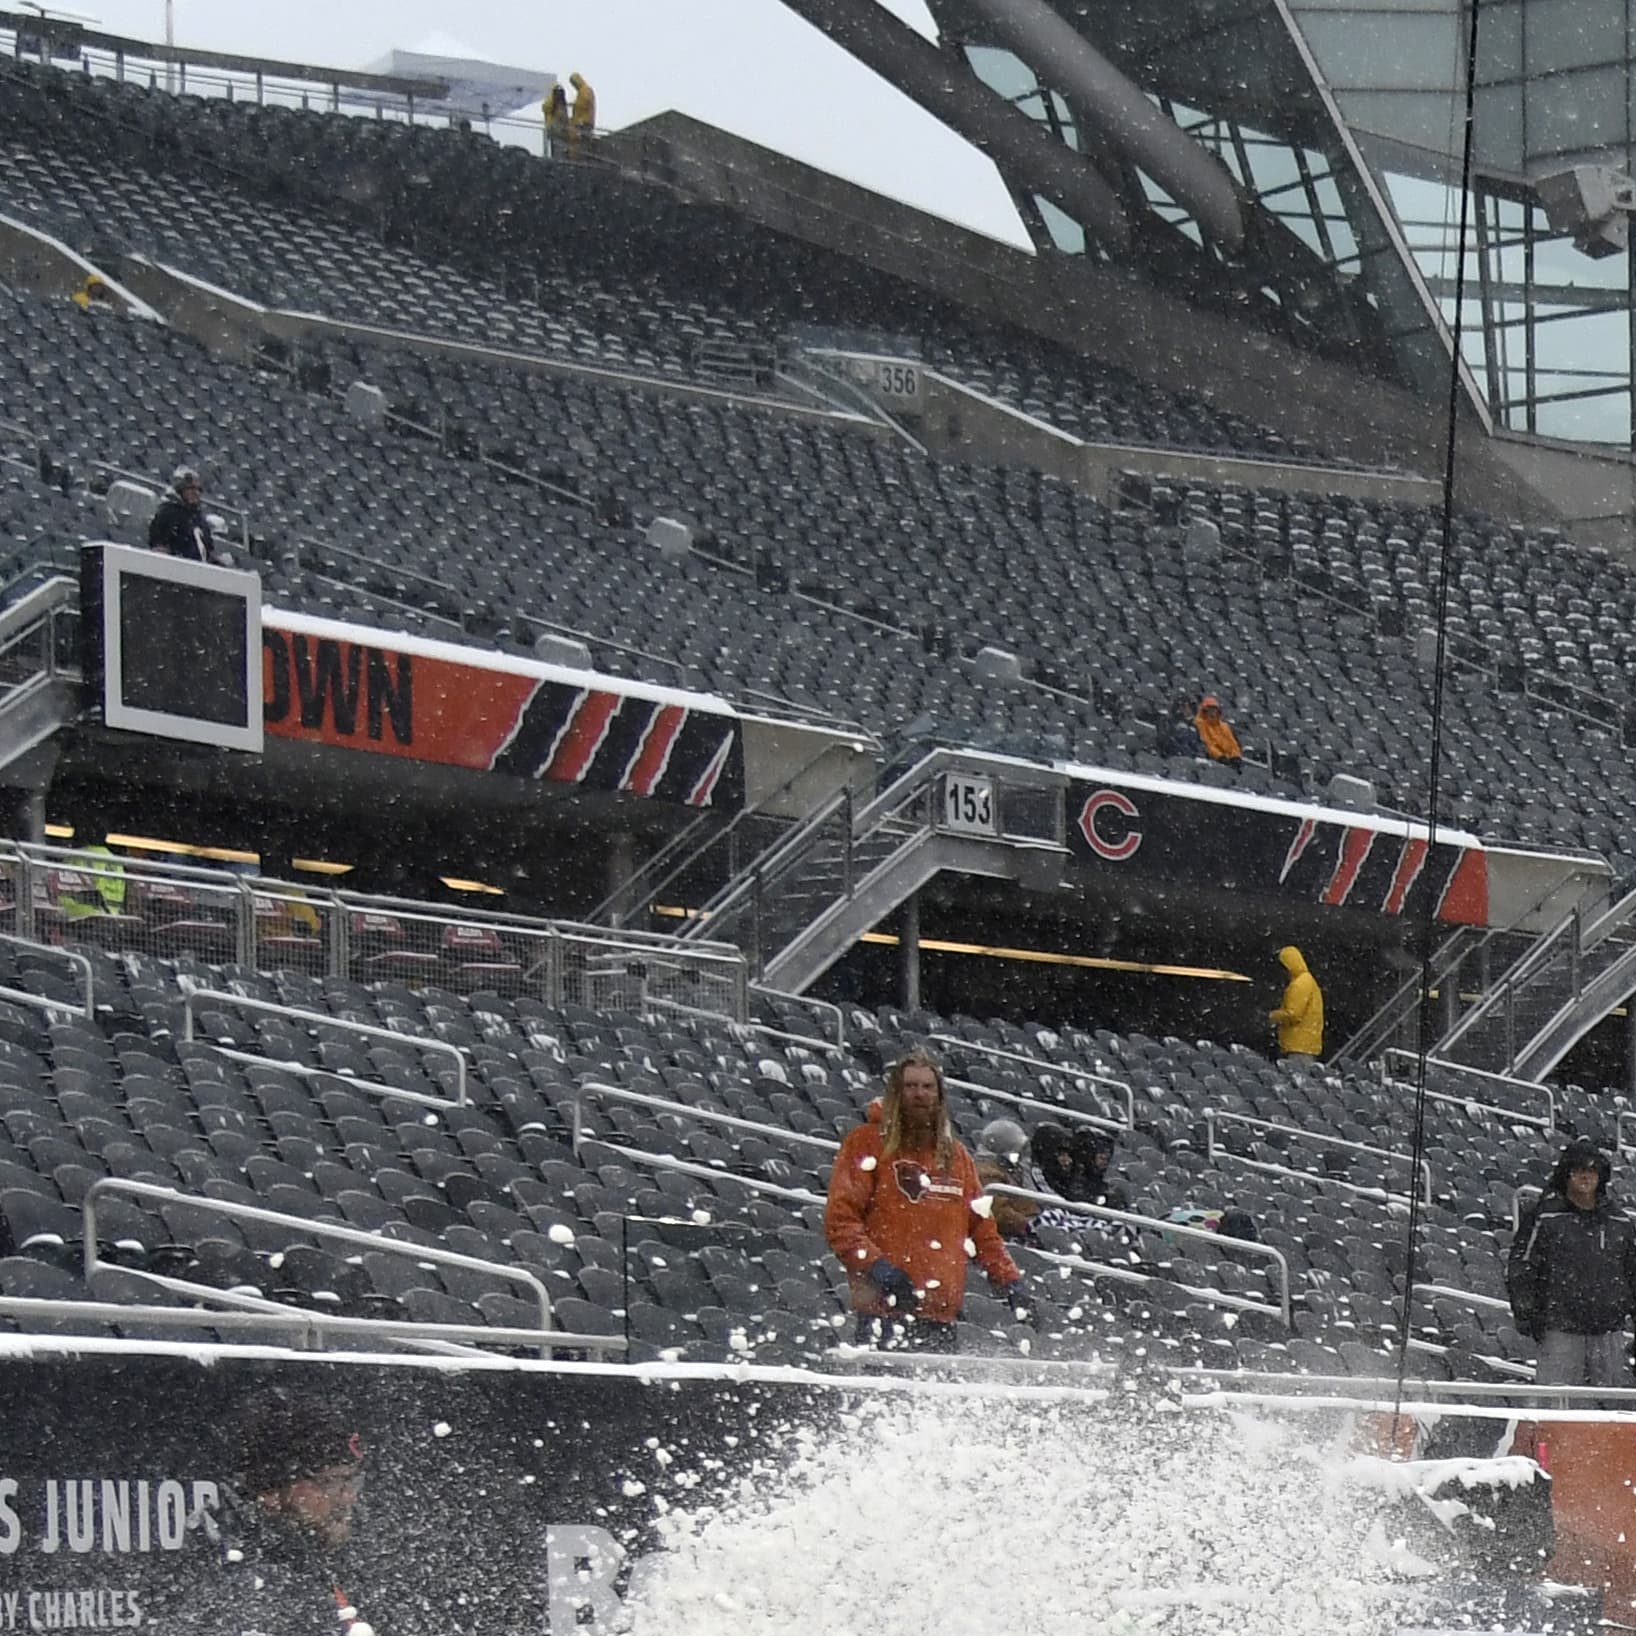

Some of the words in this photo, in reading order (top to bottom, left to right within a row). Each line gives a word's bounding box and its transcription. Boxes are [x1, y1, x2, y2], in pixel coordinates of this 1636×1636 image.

[882, 367, 916, 394] 356
[950, 783, 990, 825] 153
[1077, 789, 1143, 861] C
[43, 1479, 222, 1553] JUNIOR
[29, 1590, 142, 1630] CHARLES
